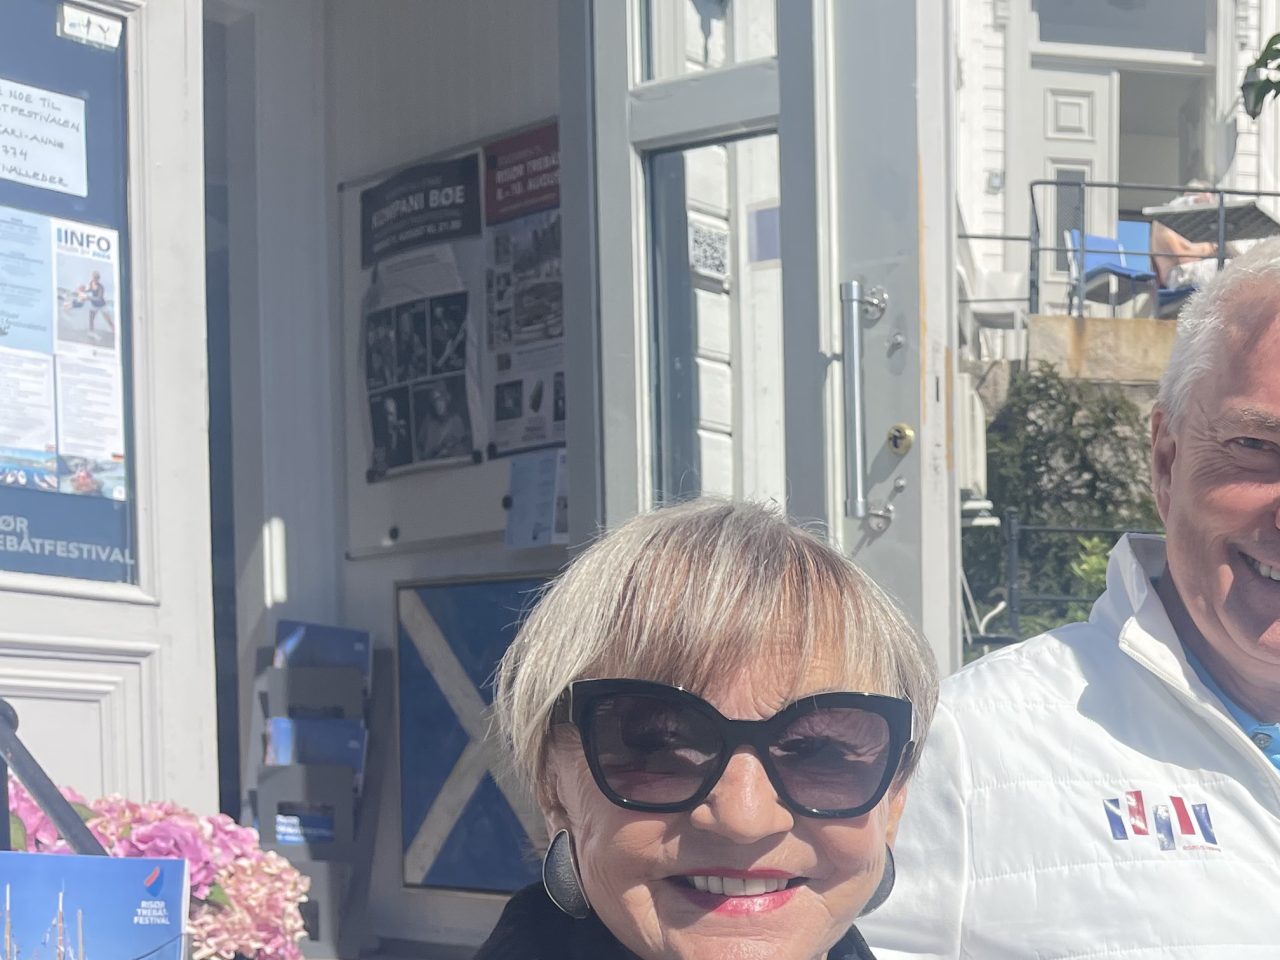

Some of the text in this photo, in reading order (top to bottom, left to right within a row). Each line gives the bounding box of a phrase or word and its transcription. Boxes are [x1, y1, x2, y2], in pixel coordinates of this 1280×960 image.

[40, 96, 61, 111] TIL
[0, 103, 81, 133] TFESTIVALEN
[0, 163, 69, 188] IVALLEDER
[64, 228, 111, 252] INFO
[133, 916, 170, 925] FESTIVAL
